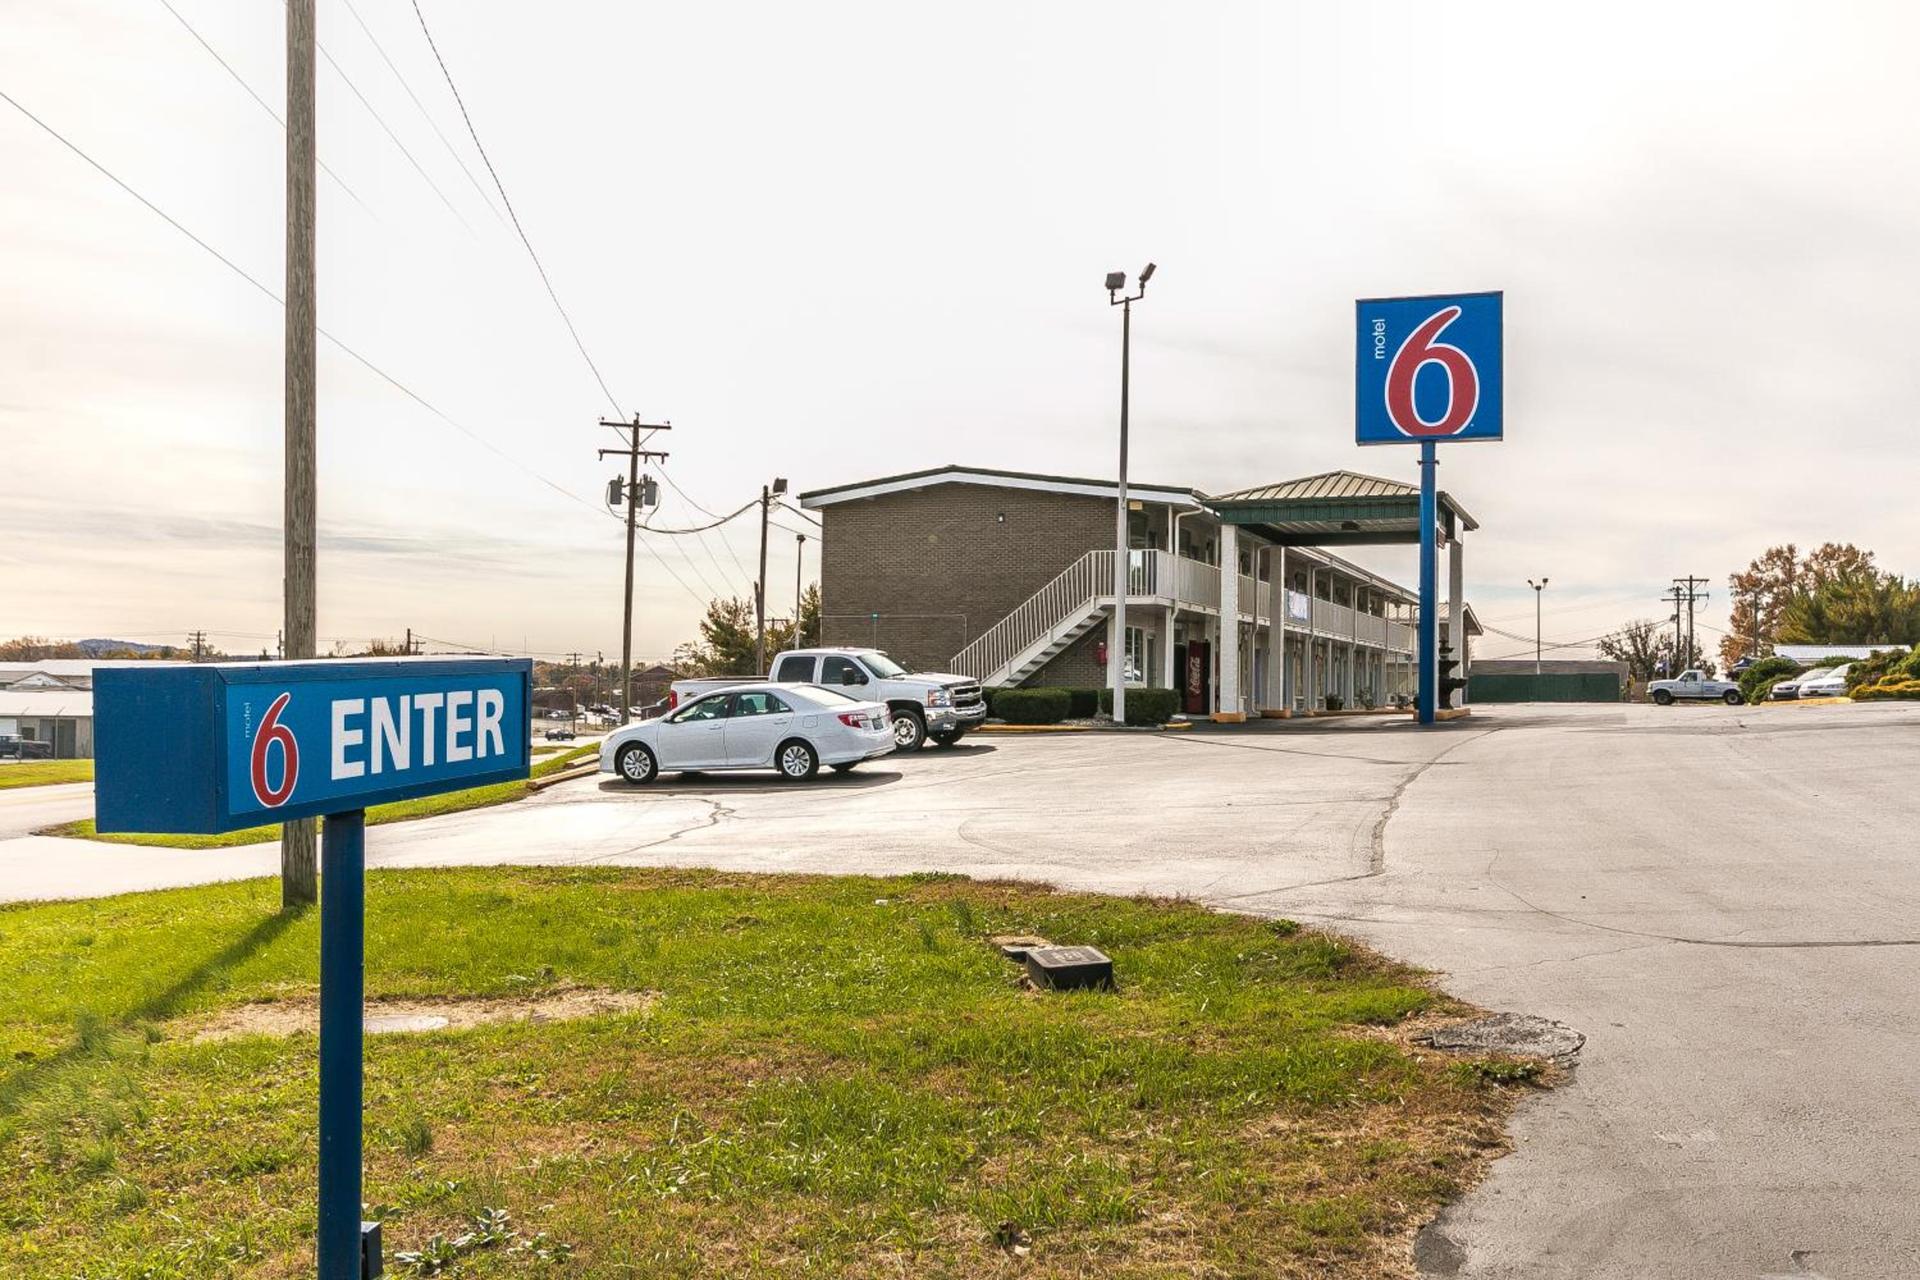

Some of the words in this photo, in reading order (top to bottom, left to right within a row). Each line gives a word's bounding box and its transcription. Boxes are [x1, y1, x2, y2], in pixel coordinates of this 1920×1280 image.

[1372, 318, 1385, 359] motel
[1385, 305, 1480, 436] 6
[243, 702, 251, 738] motel
[251, 692, 299, 808] 6
[331, 688, 504, 781] ENTER
